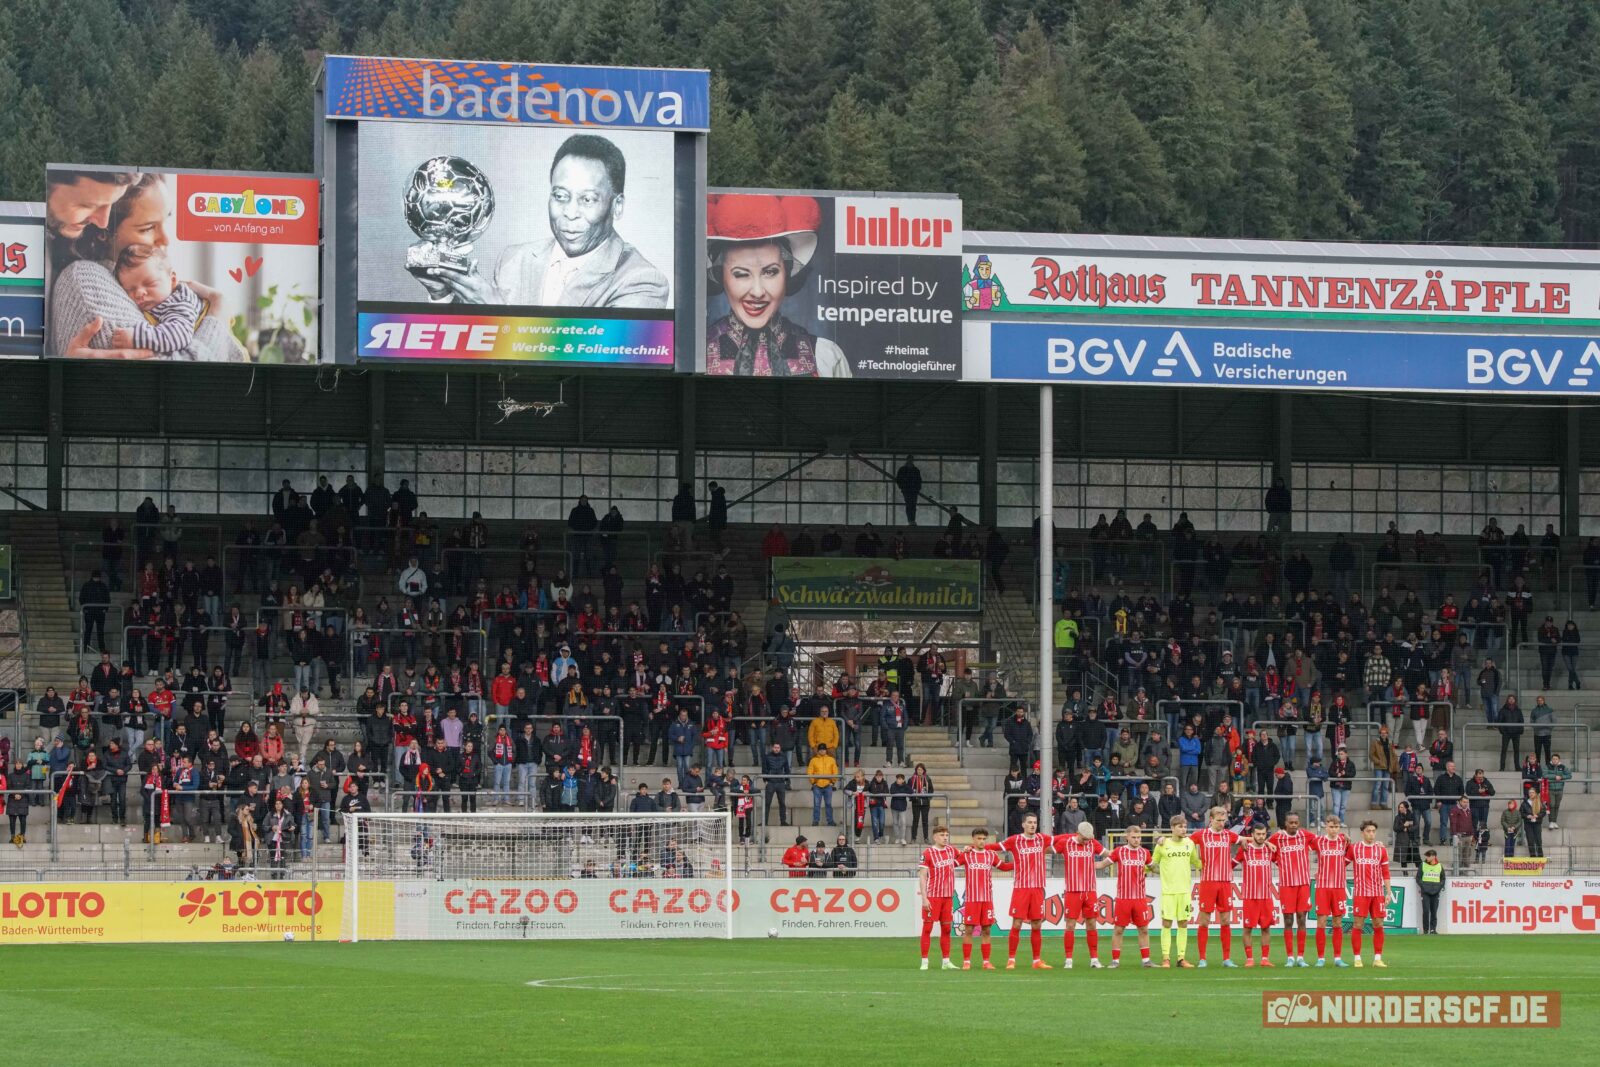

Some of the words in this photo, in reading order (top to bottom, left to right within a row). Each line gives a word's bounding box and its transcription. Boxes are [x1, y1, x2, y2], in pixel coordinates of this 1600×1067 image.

[422, 68, 683, 126] badenova
[194, 189, 298, 215] BABY1ONE
[234, 222, 268, 236] Anfang
[269, 224, 284, 235] an!
[846, 206, 953, 248] huber
[818, 275, 904, 298] Inspired
[912, 277, 939, 300] by
[1029, 257, 1167, 308] Rothaus
[1191, 269, 1570, 314] TANNENZÄPFLE
[817, 304, 953, 327] temperature
[517, 325, 604, 337] www.rete.de
[512, 341, 560, 354] Werbe-
[563, 342, 574, 353] &
[577, 342, 669, 356] Folientechnik
[885, 345, 929, 357] #heimat
[1047, 337, 1147, 377] BGV
[1213, 342, 1293, 360] Badische
[857, 360, 956, 373] #Technologieführer
[1213, 362, 1347, 385] Versicherungen
[1467, 347, 1563, 386] BGV
[778, 584, 973, 606] Schwarzwaldmilch
[1020, 846, 1042, 855] CAZOO
[935, 859, 954, 868] CAZO
[1452, 880, 1483, 890] hilzinger
[1501, 880, 1525, 888] Fenster
[1532, 880, 1563, 890] hilzinger
[2, 892, 105, 919] LOTTO
[222, 890, 323, 917] LOTTO
[444, 889, 579, 914] CAZOO
[609, 888, 740, 914] CAZOO
[770, 888, 900, 913] CAZOO
[457, 920, 491, 930] Finden.
[531, 920, 566, 930] Freuen.
[620, 920, 655, 929] Finden.
[782, 919, 816, 929] Finden.
[818, 919, 853, 929] Fahren.
[854, 919, 888, 929] Freuen.
[1452, 900, 1568, 931] hilzinger
[1, 925, 104, 937] Baden-Württemberg
[222, 923, 322, 936] Baden-Württemberg
